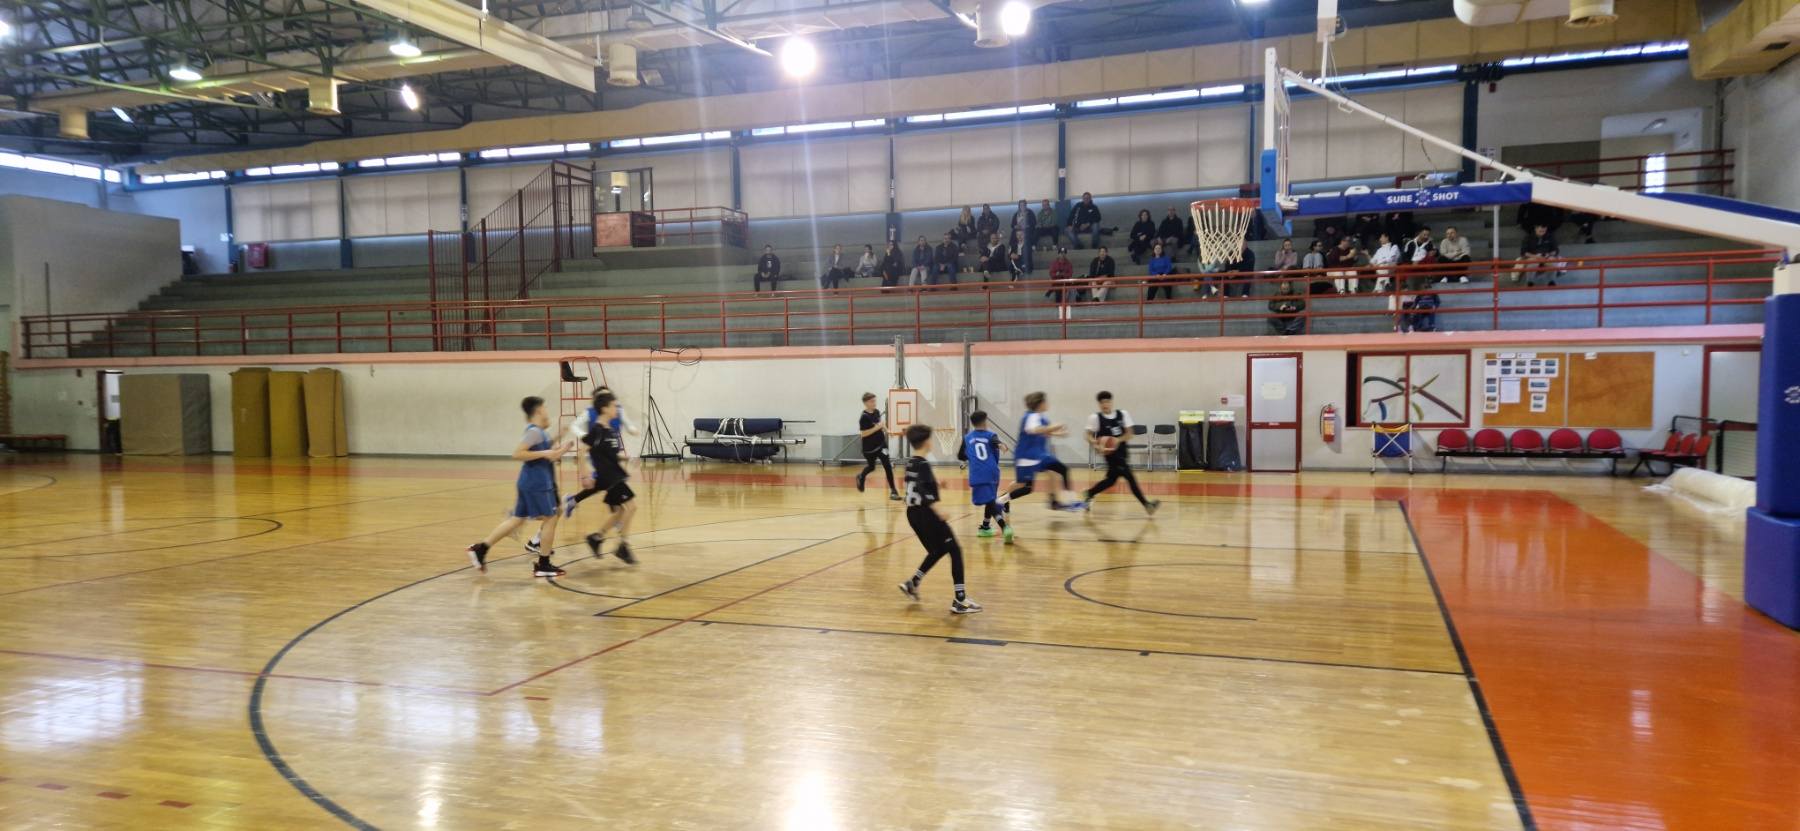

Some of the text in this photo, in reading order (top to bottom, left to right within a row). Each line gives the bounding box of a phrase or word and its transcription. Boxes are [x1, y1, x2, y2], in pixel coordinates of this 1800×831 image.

[1386, 191, 1459, 204] SURE SHOT
[975, 443, 988, 461] 0
